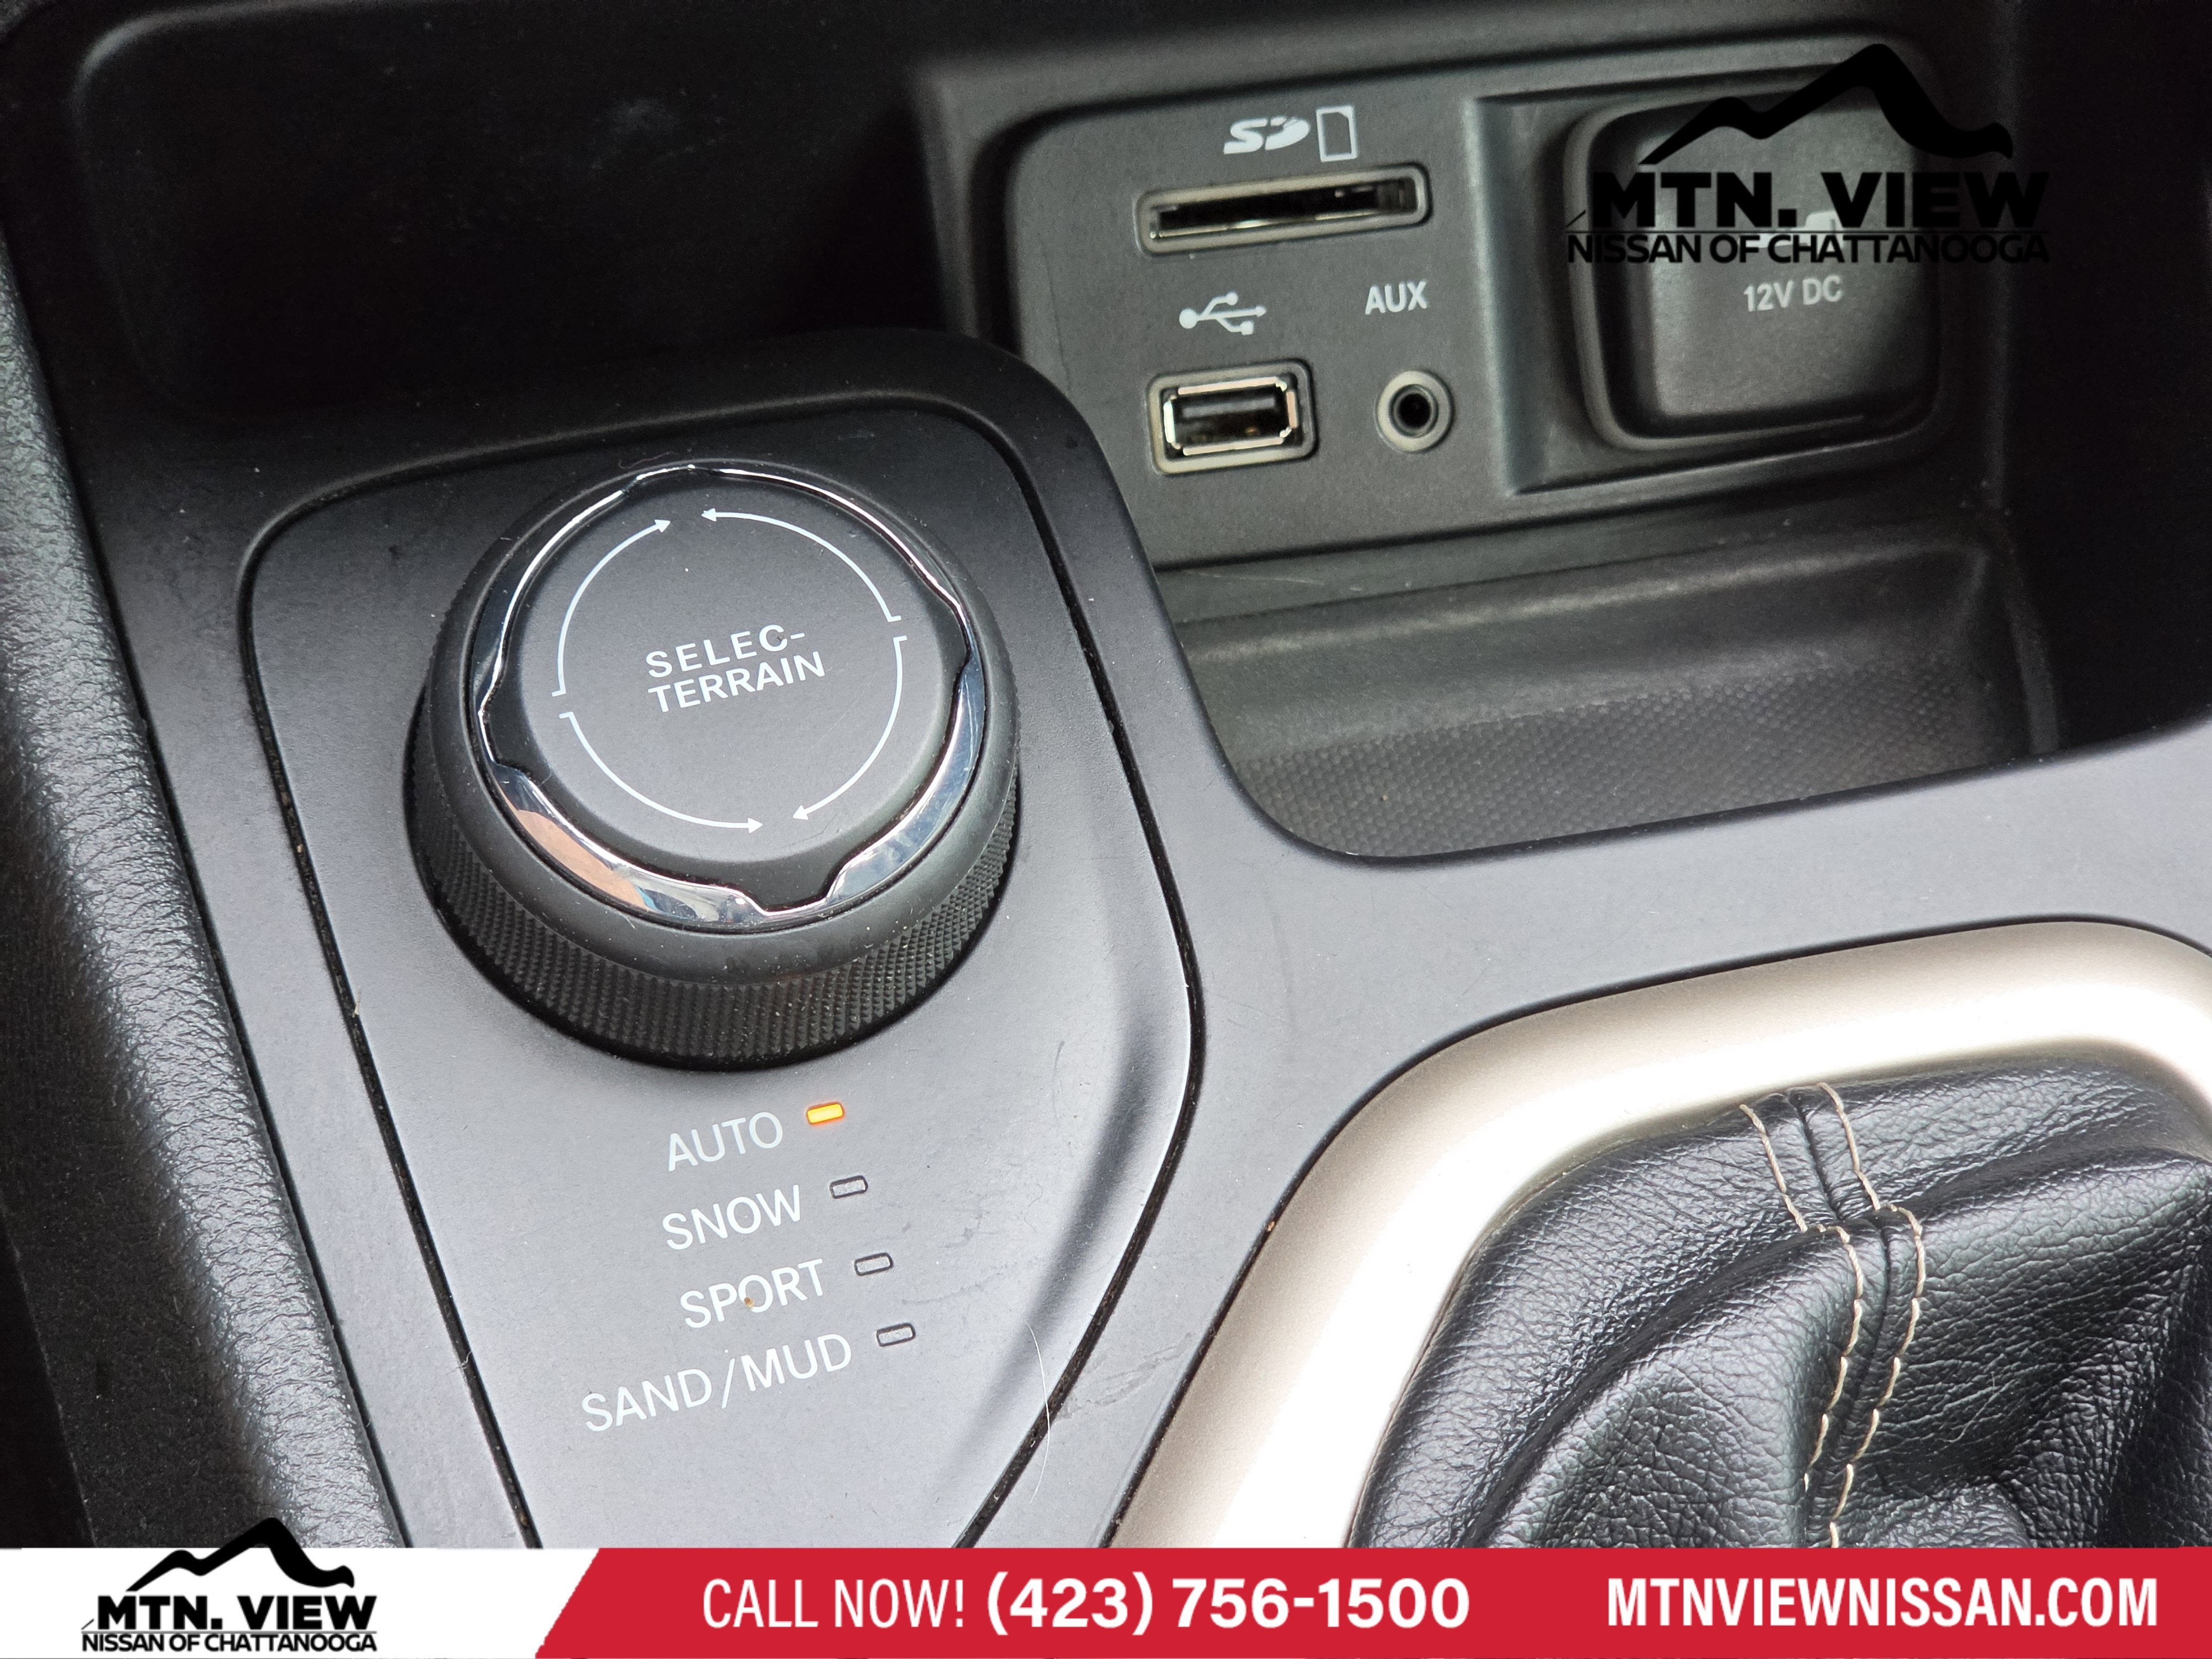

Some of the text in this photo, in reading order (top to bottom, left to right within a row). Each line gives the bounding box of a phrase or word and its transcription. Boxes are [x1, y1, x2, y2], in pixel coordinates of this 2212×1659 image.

[1364, 281, 1428, 315] AUX
[1743, 275, 1844, 311] 12V DC
[645, 624, 805, 678] SELEC-
[648, 651, 825, 712] TERRAIN
[669, 1112, 782, 1171] AUTO
[662, 1185, 800, 1250] SNOW
[680, 1259, 822, 1328] SPORT
[581, 1334, 851, 1432] SAND/MUD
